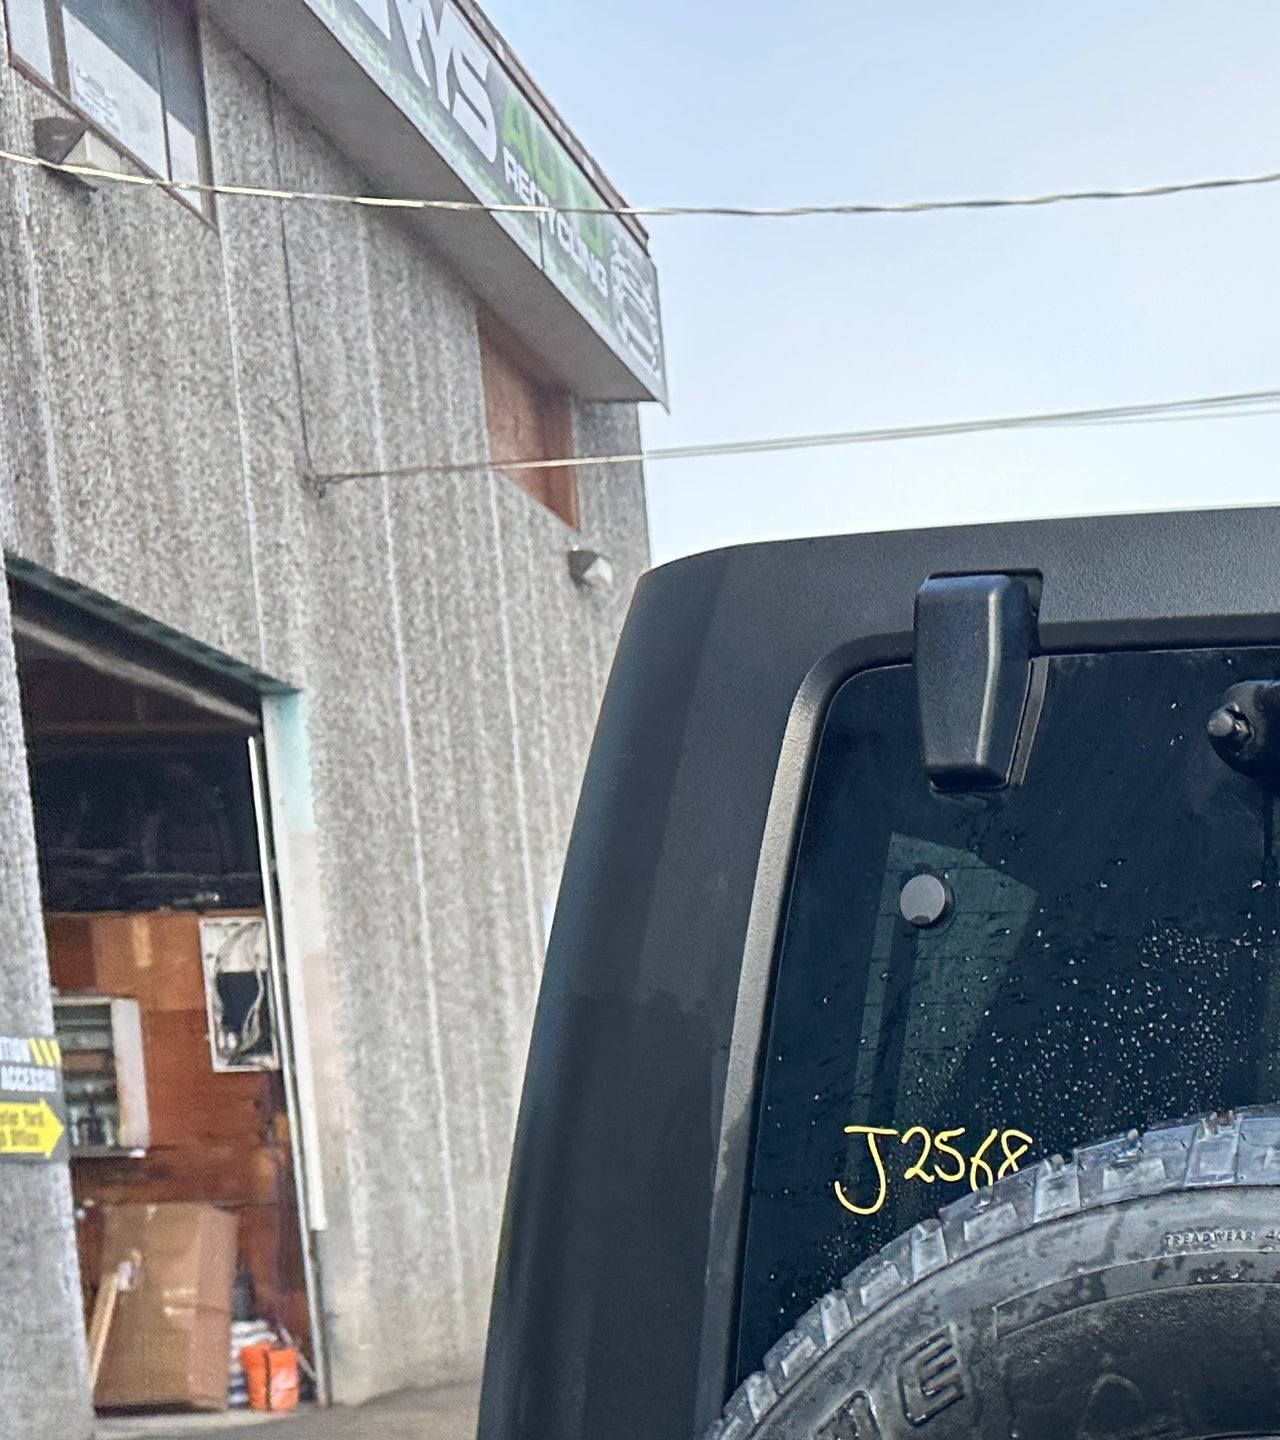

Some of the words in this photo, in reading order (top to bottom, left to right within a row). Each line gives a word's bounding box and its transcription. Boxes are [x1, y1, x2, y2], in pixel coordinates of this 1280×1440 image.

[503, 146, 608, 298] RECYCLING
[834, 1125, 1033, 1215] J2568
[1164, 1230, 1256, 1248] TREADWEAR
